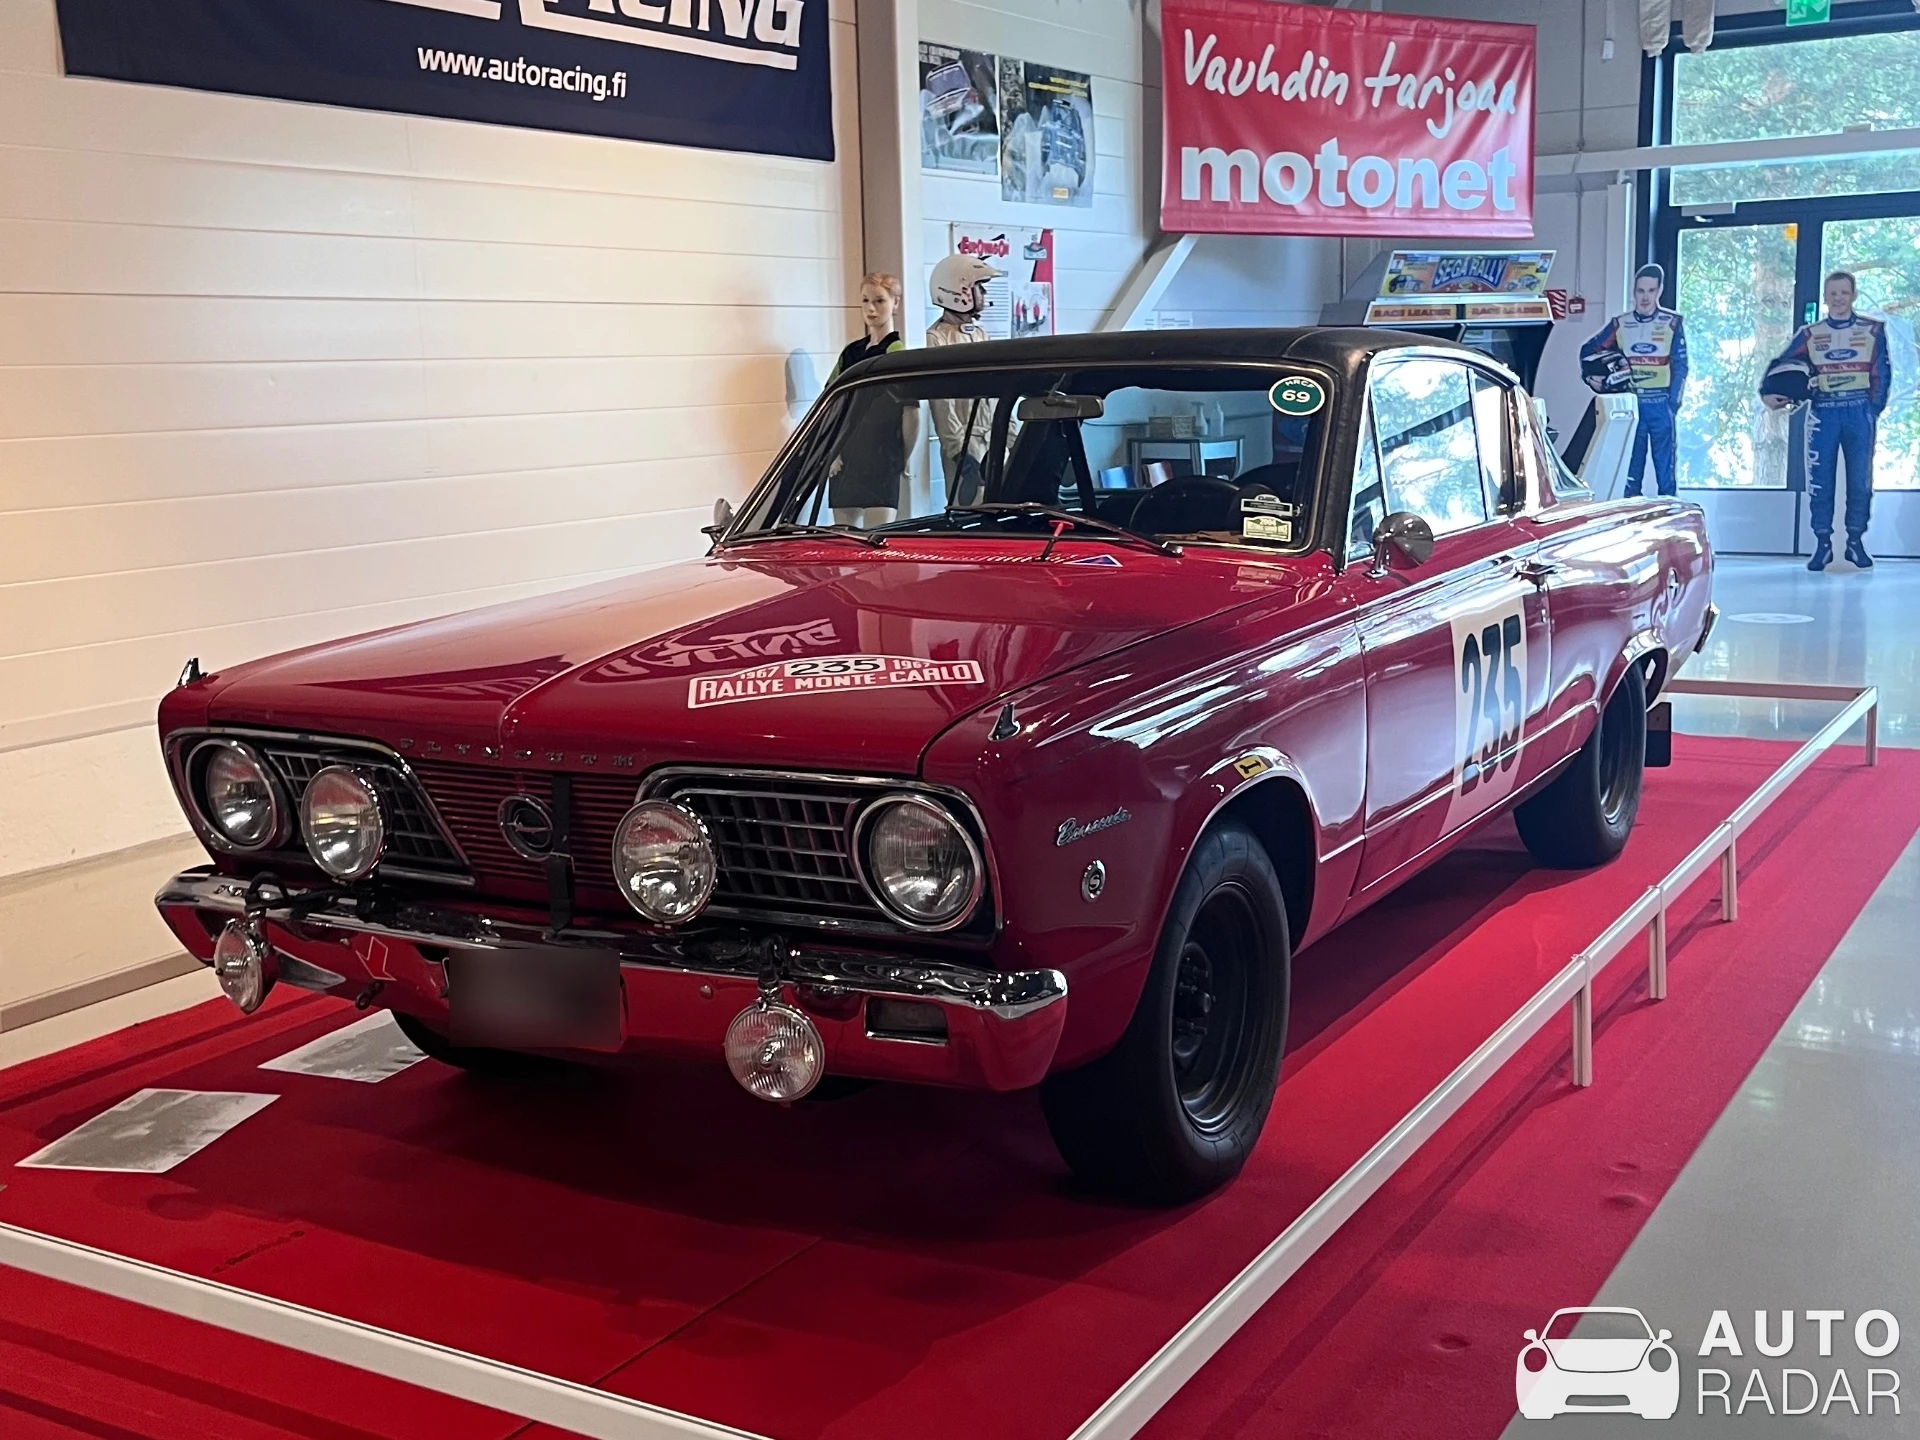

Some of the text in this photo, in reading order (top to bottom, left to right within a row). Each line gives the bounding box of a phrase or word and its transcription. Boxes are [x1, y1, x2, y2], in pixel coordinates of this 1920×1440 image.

[417, 47, 627, 101] www.autoracing.fi
[1184, 28, 1516, 139] Vauhdin tarjoaa
[1181, 137, 1516, 211] motonet
[1434, 256, 1470, 284] SEGA
[1470, 256, 1508, 285] RALLY
[1374, 308, 1450, 318] RACE LEADER
[1281, 389, 1311, 403] 69
[700, 664, 972, 701] RALLYE MONTE-CARLO
[740, 659, 931, 680] 1967 235 1967
[1460, 613, 1522, 797] 235
[400, 738, 633, 767] PLYMOUTH
